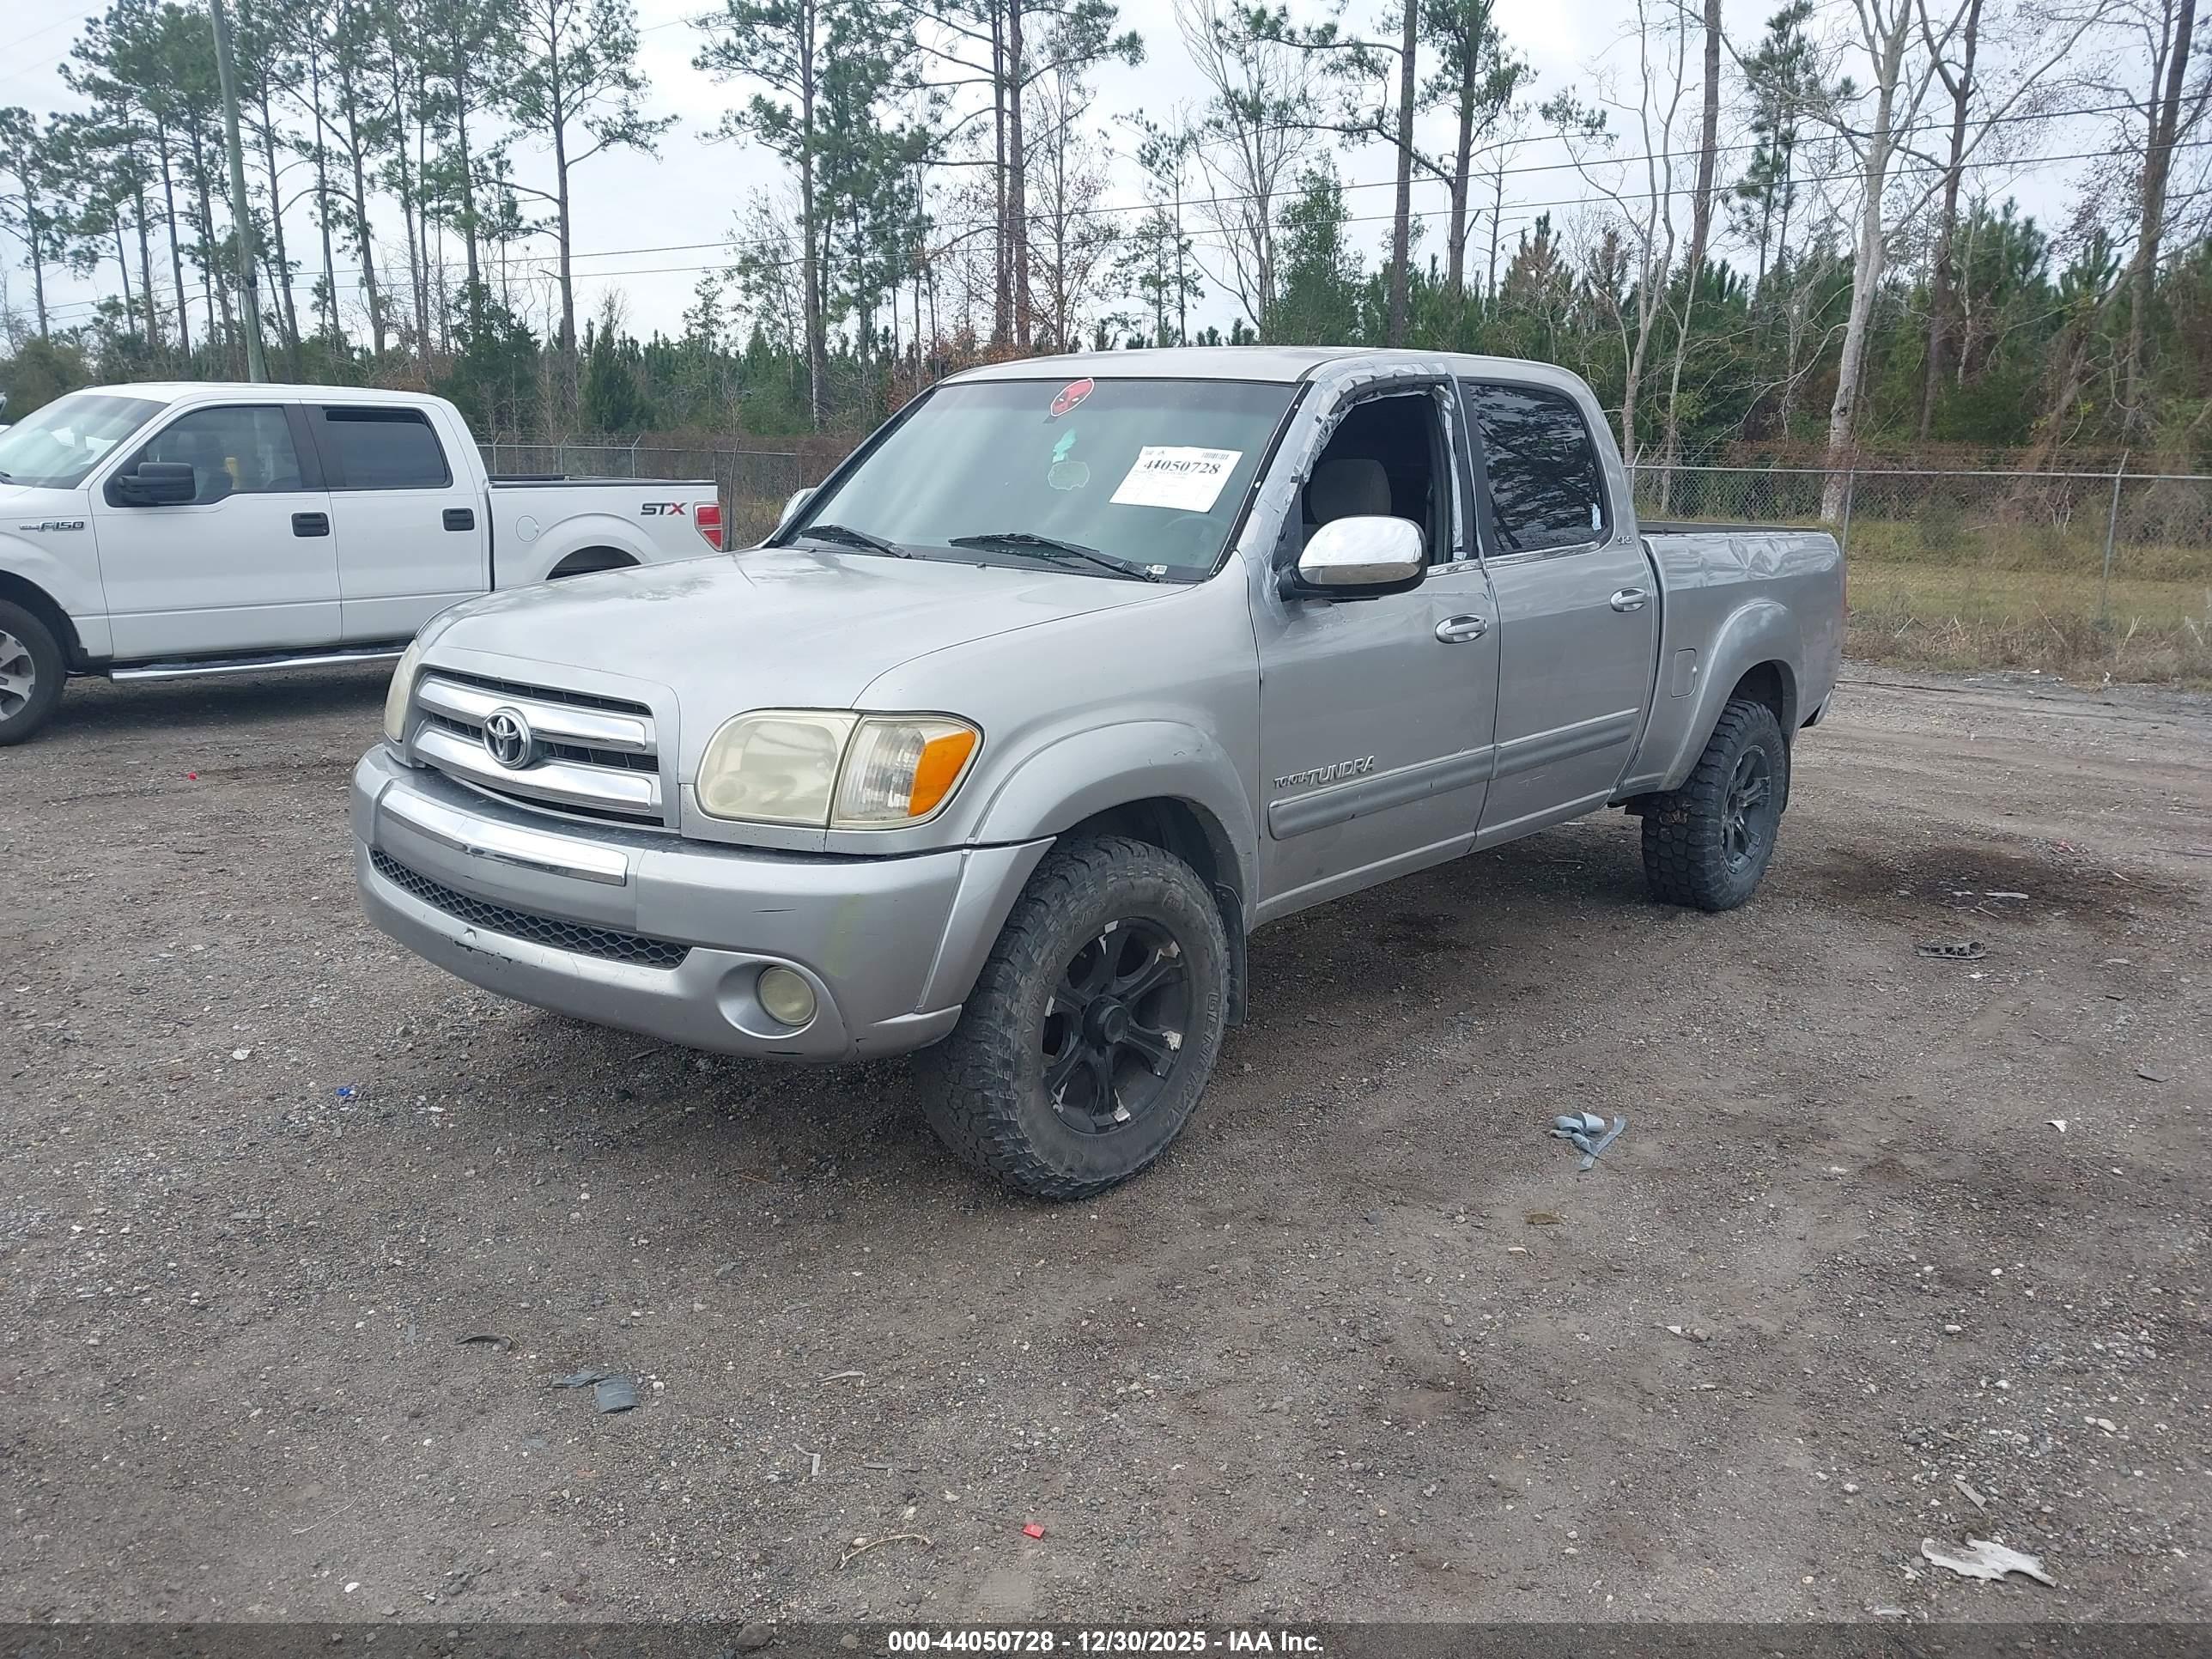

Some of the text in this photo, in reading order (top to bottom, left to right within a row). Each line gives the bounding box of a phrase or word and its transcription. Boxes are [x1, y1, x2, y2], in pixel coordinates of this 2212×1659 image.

[1143, 459, 1222, 475] 44050728
[641, 501, 688, 516] STX
[1305, 755, 1375, 787] TUNDRA
